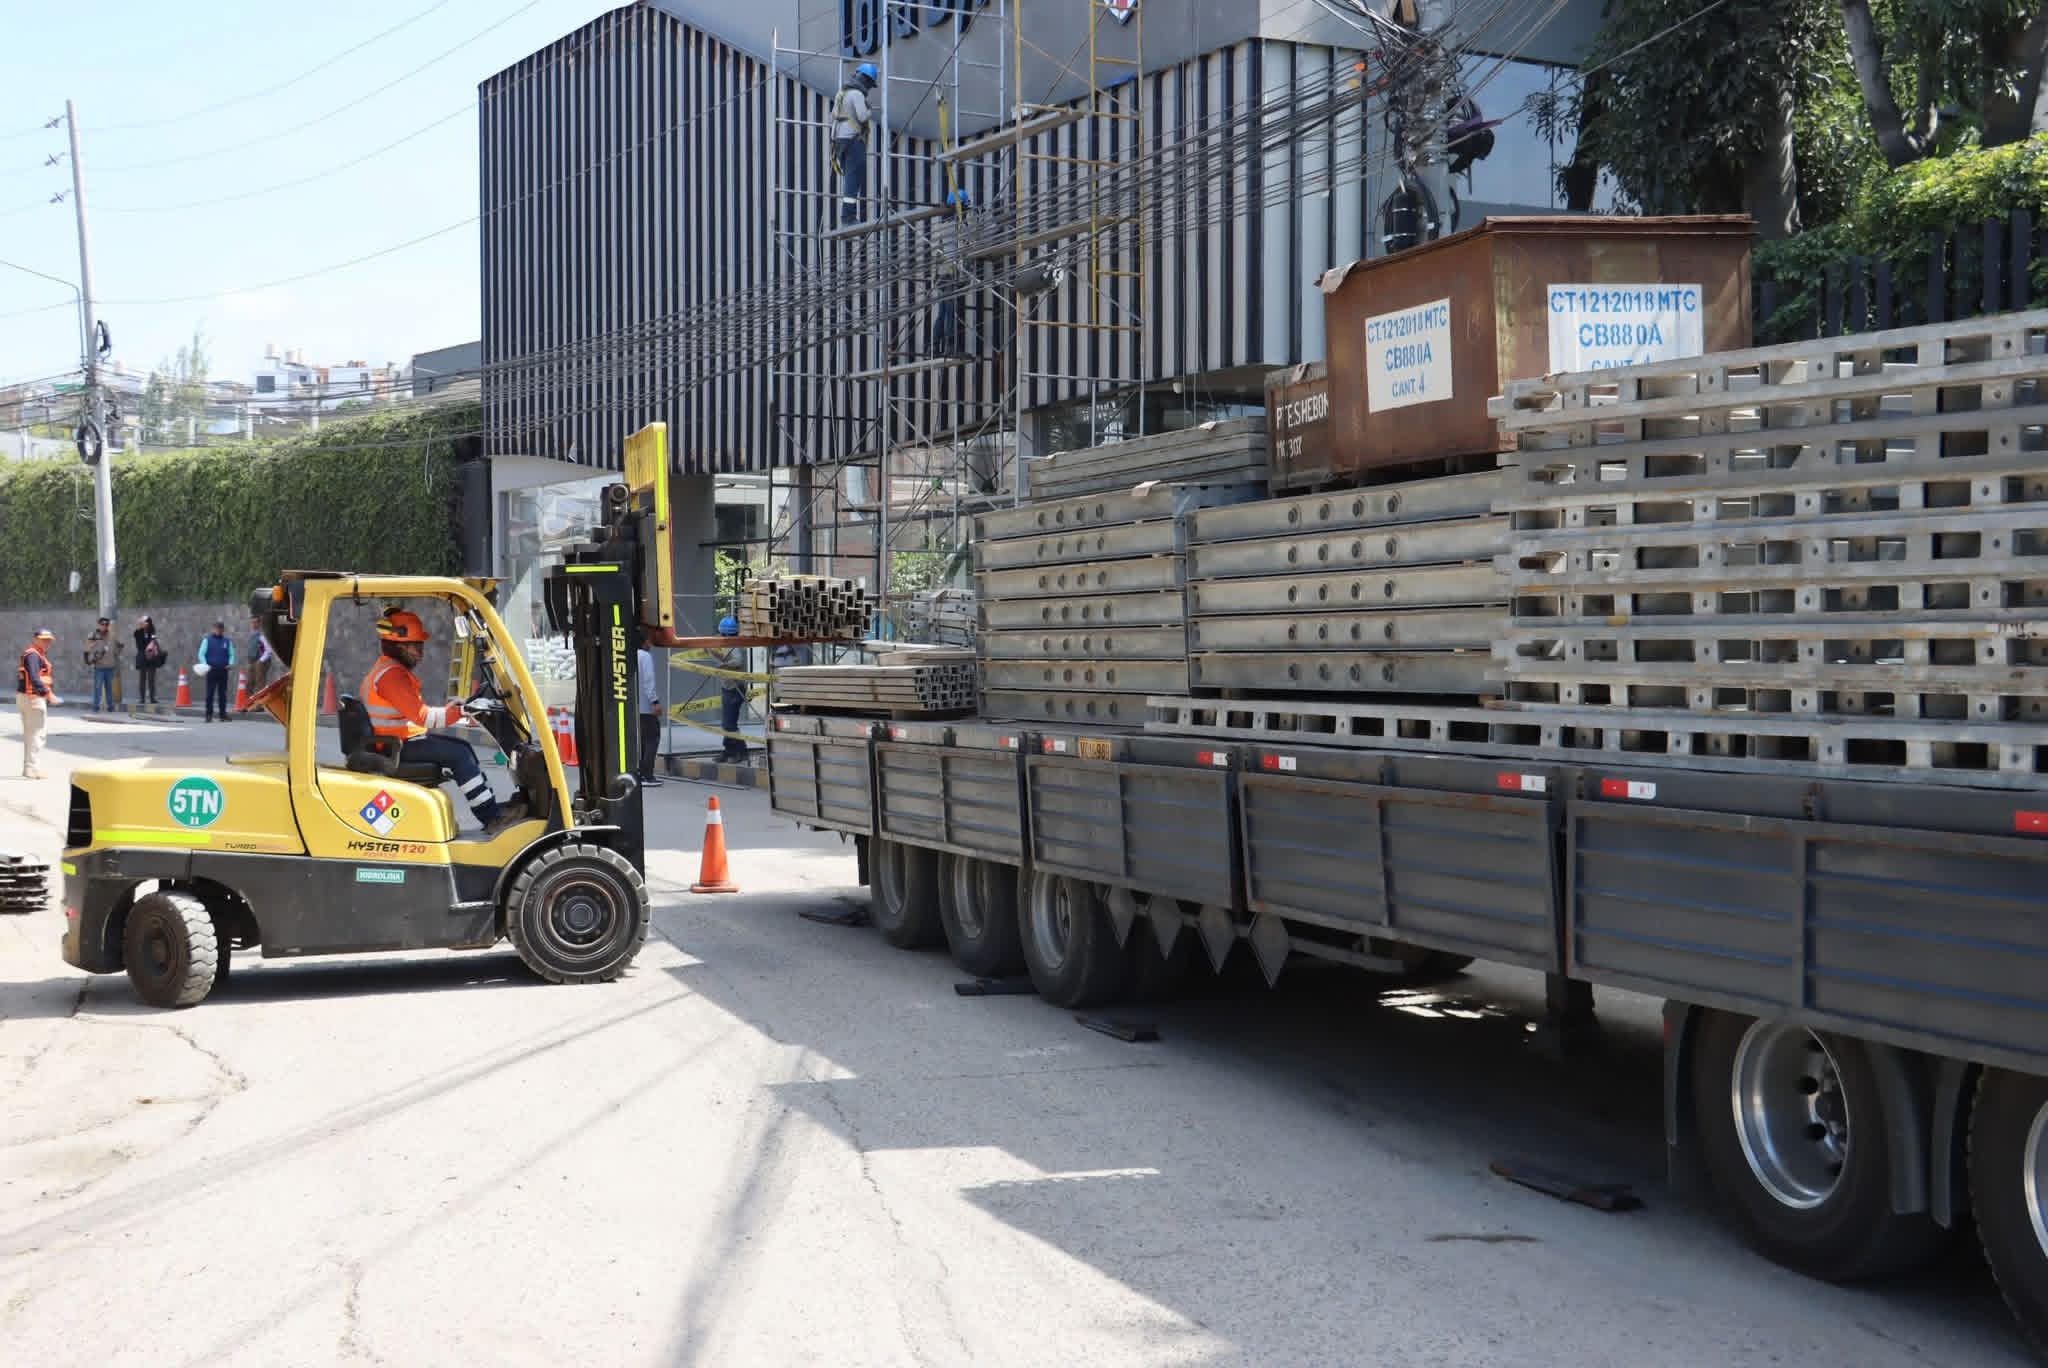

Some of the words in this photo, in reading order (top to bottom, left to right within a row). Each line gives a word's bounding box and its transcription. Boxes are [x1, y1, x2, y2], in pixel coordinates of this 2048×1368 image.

[611, 626, 628, 701] HYSTER
[172, 788, 220, 814] 5TN
[379, 796, 387, 808] 1
[365, 807, 376, 819] 0
[390, 807, 400, 819] 0
[347, 841, 400, 853] HYSTER
[401, 844, 427, 854] 120
